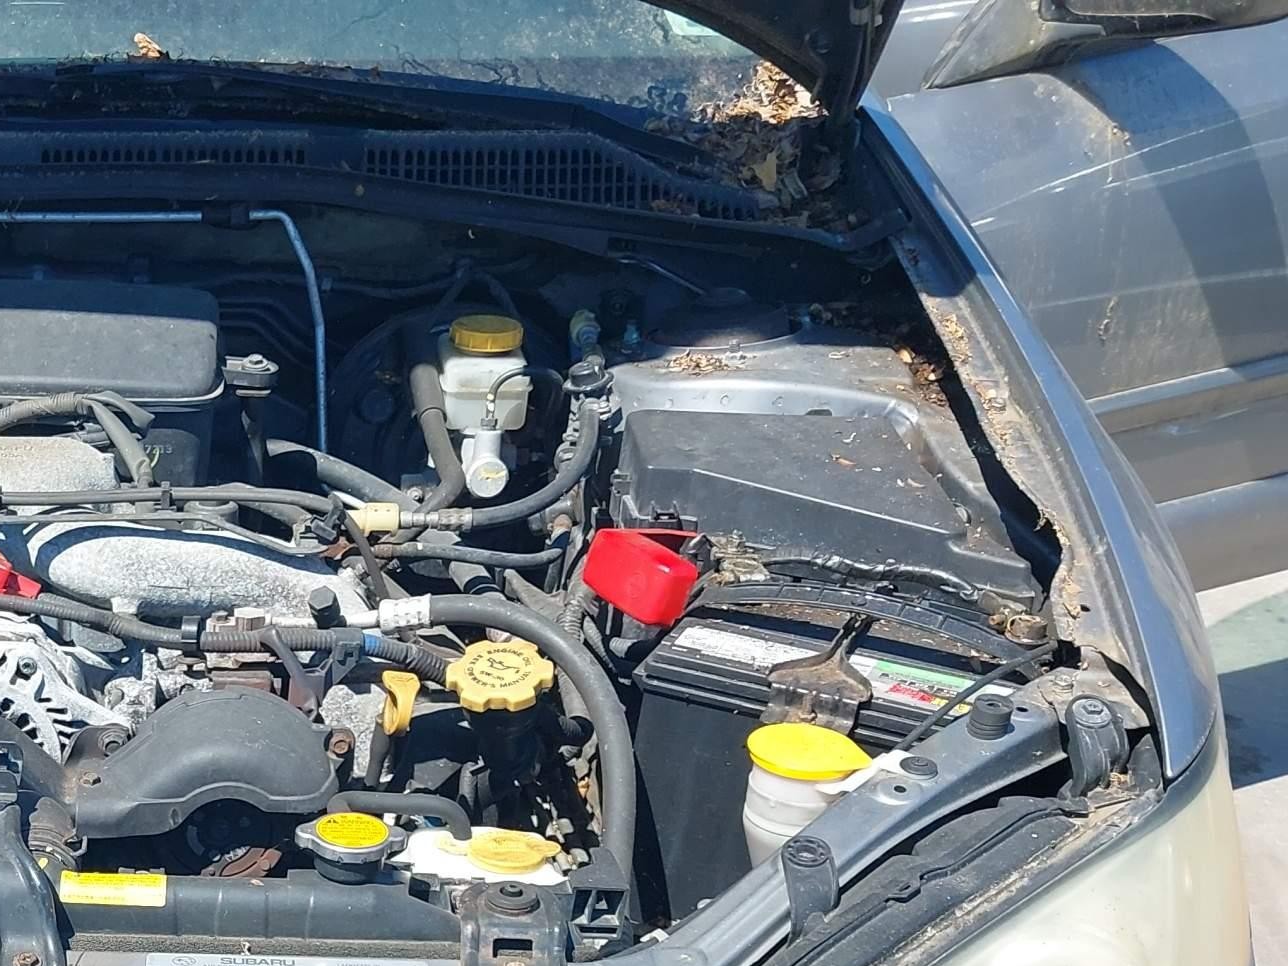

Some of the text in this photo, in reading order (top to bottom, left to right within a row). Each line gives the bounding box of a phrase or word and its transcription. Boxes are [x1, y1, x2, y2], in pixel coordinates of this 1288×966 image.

[486, 647, 524, 657] ENGINE
[499, 671, 532, 688] MANUAL
[220, 957, 296, 966] SUBARU
